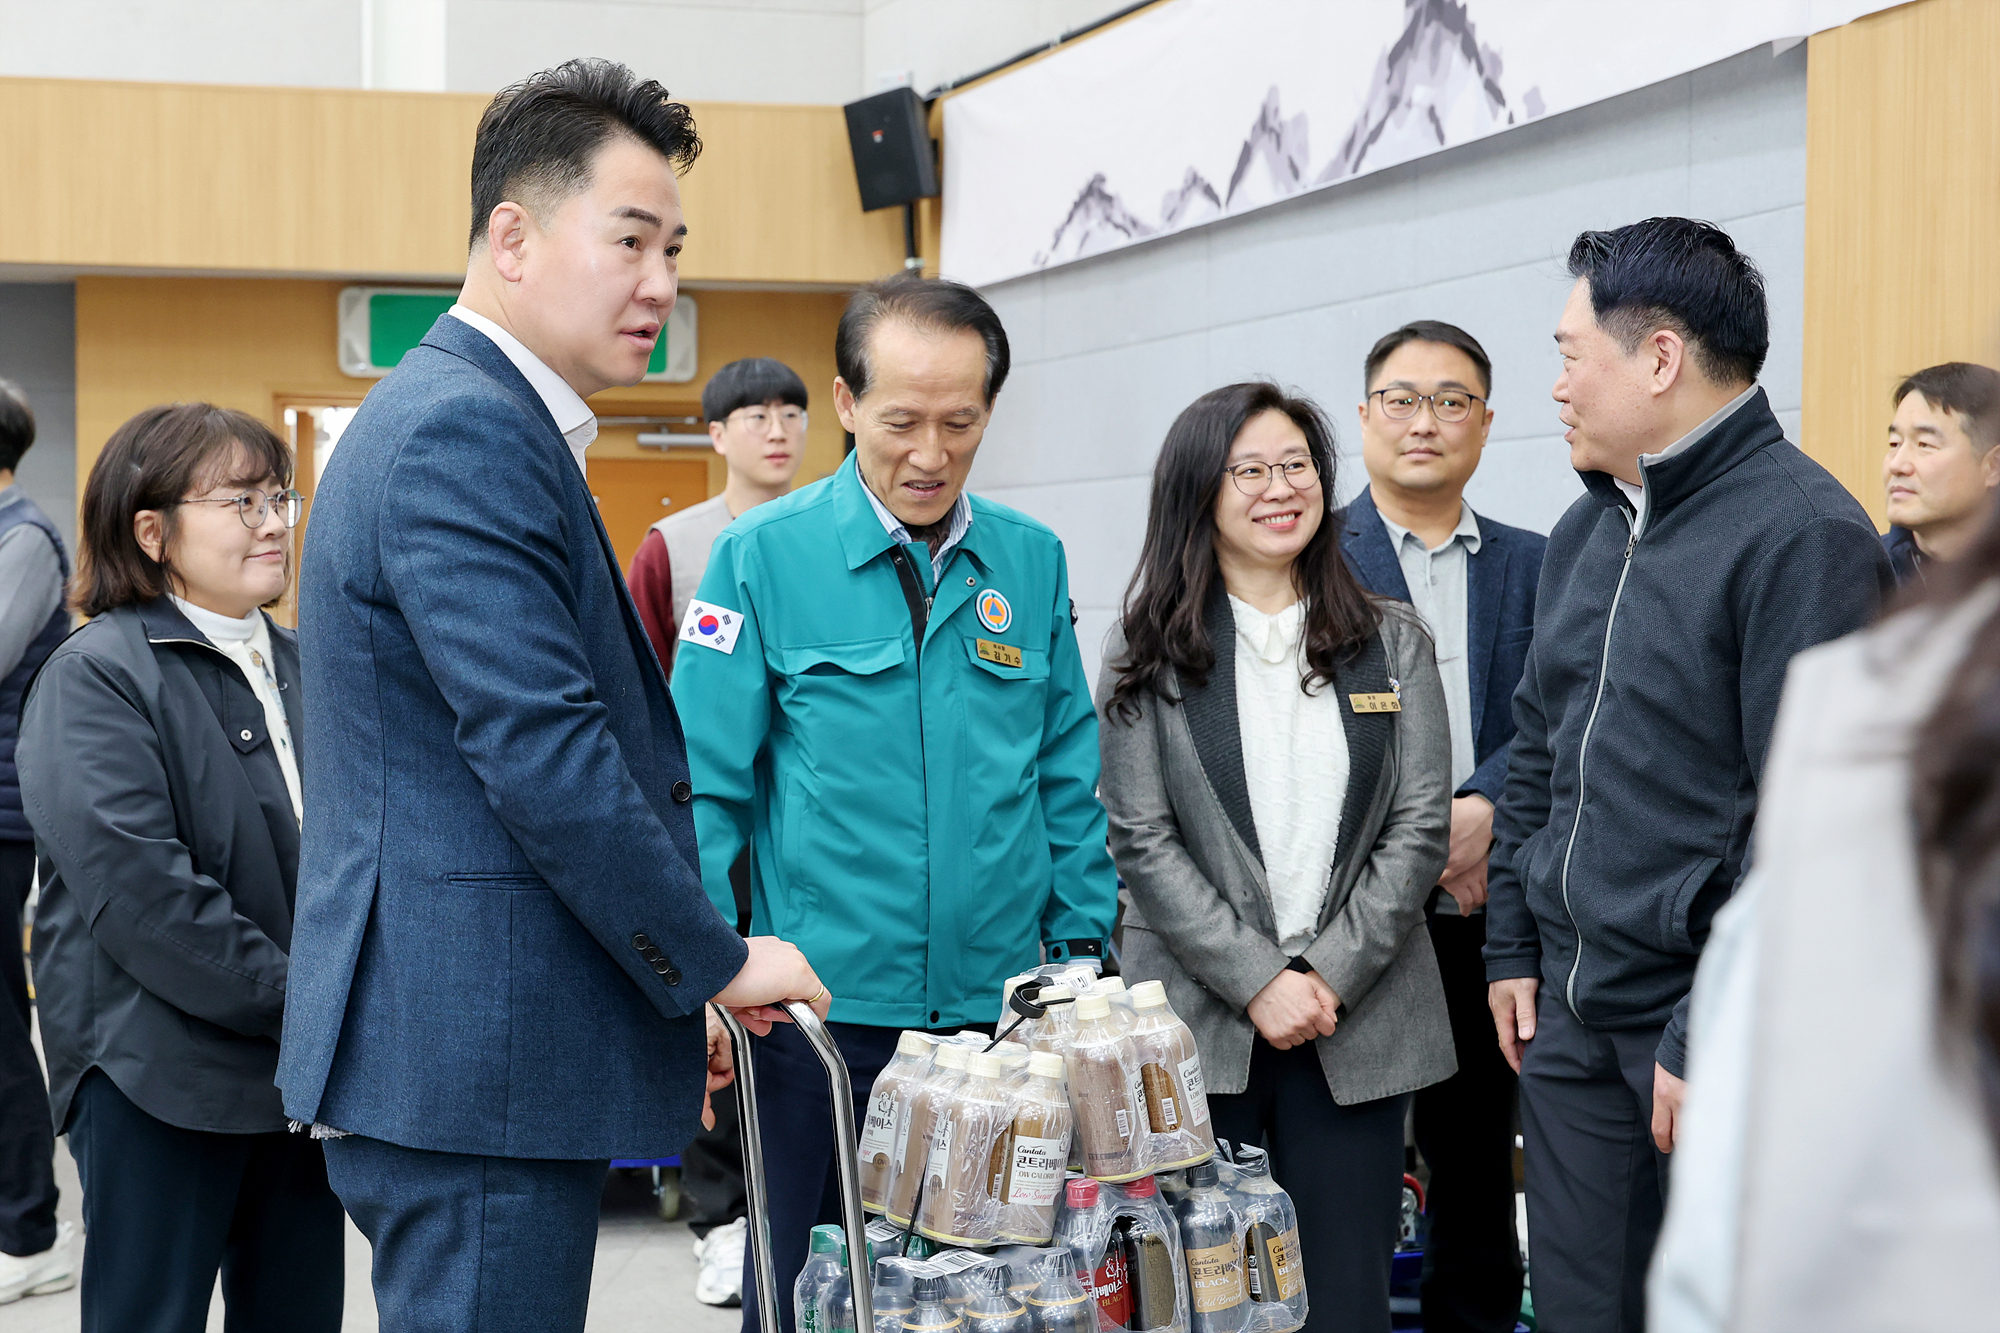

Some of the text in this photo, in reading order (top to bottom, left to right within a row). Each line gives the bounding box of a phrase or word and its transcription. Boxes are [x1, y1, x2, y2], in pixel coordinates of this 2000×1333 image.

[1017, 1145, 1046, 1156] Cantata
[1011, 1188, 1031, 1198] Low
[1194, 1276, 1230, 1289] BLACK
